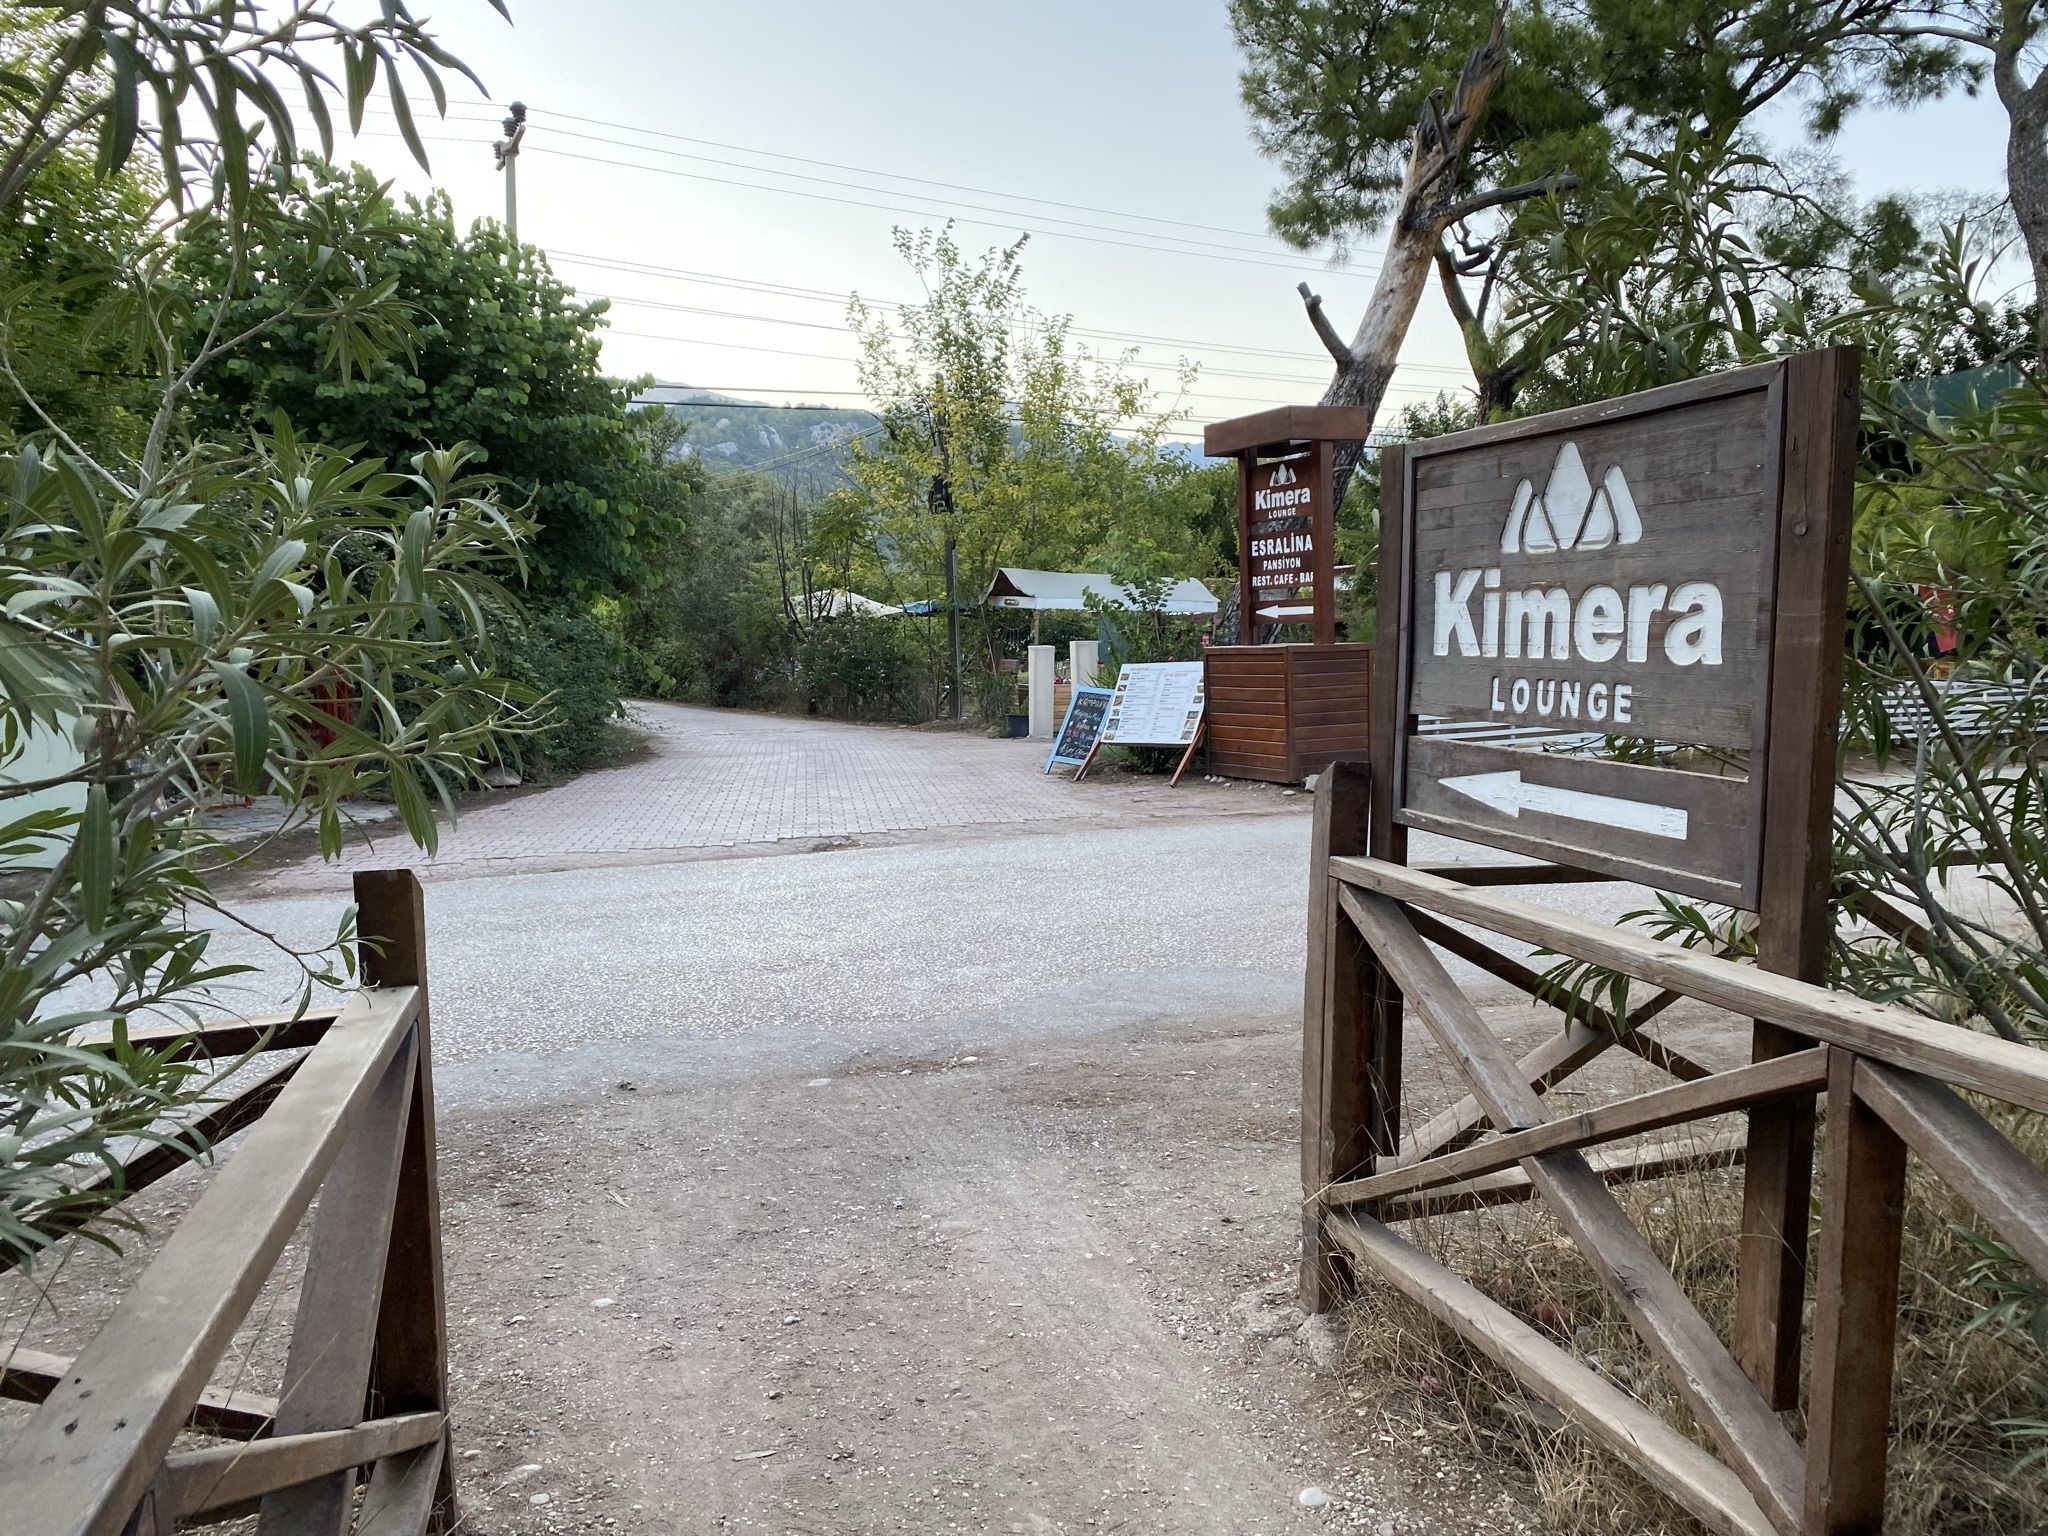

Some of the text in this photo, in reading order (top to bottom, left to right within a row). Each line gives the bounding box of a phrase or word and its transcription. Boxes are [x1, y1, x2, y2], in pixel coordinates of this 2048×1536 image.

[1255, 487, 1311, 510] Kimera
[1268, 507, 1296, 519] LOUNGE
[1251, 533, 1313, 557] ESRALİNA
[1263, 556, 1301, 571] PANSİYON
[1252, 575, 1272, 587] REST.
[1274, 573, 1293, 585] CAFE
[1433, 567, 1723, 665] Kimera
[1491, 676, 1633, 723] LOUNGE
